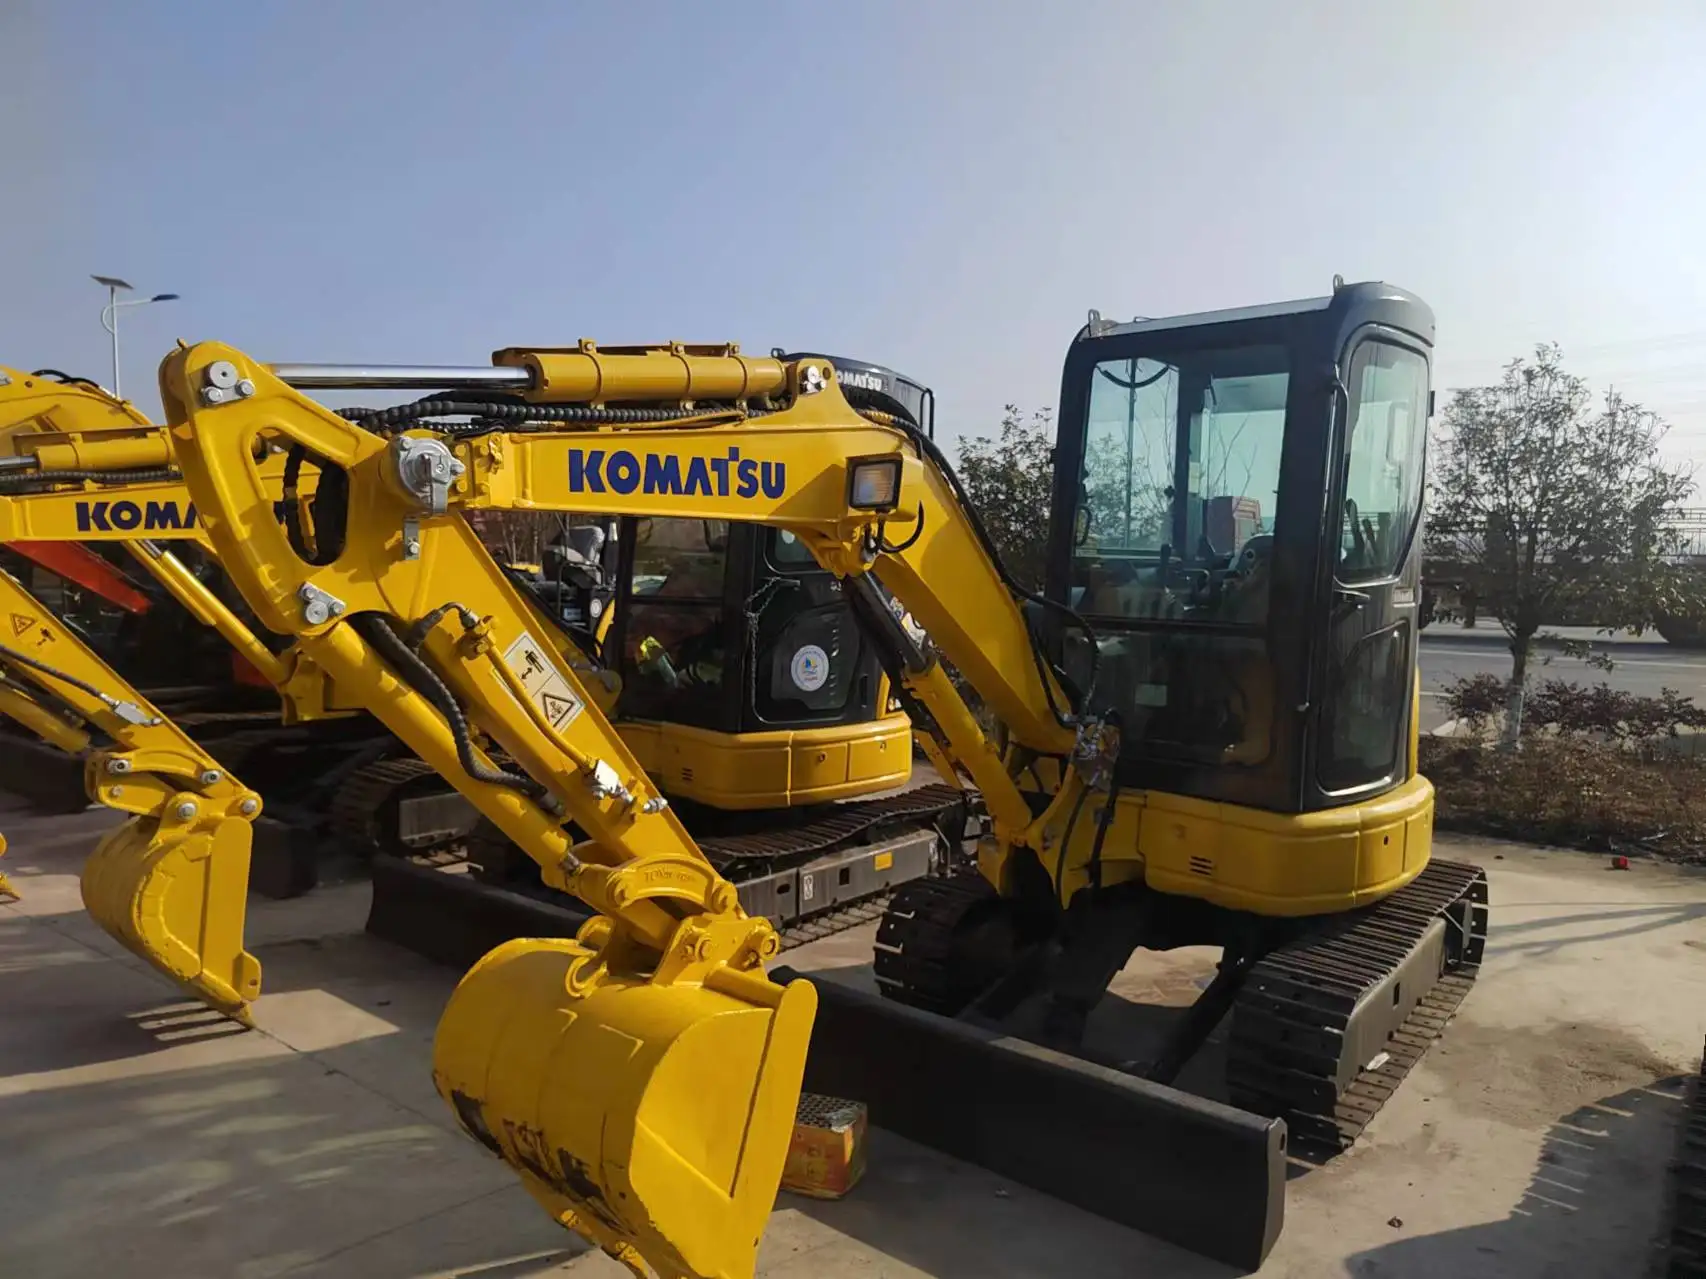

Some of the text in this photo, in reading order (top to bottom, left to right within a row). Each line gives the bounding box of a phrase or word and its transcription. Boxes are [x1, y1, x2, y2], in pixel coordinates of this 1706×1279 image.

[836, 371, 882, 391] OMATSU
[568, 446, 786, 500] KOMATSU
[75, 501, 203, 532] KOMA
